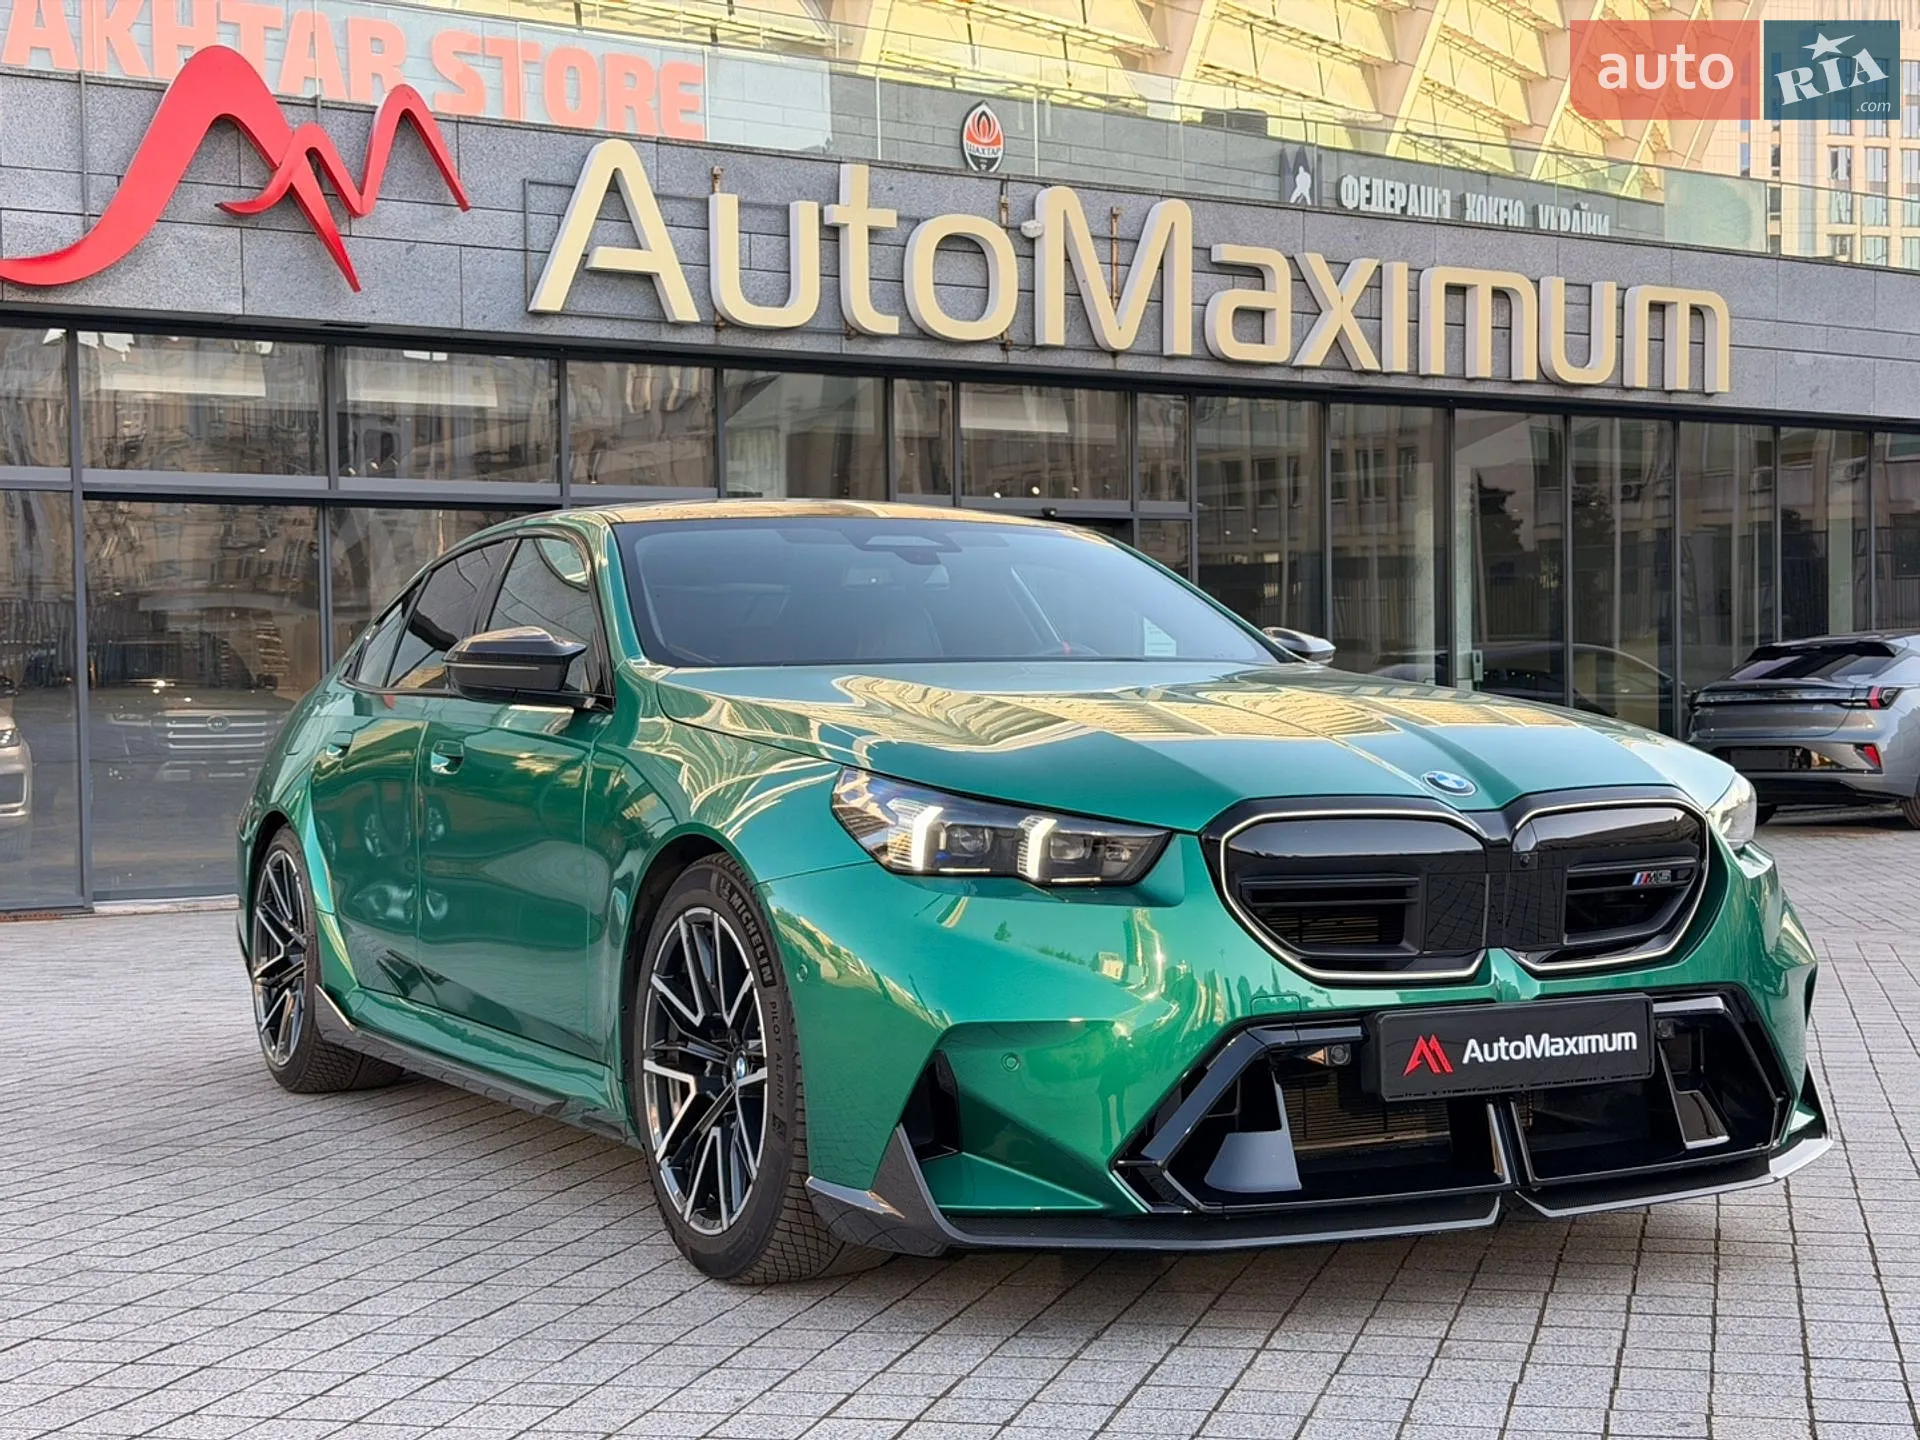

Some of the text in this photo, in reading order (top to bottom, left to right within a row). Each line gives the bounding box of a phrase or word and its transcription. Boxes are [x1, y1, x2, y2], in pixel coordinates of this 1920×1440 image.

[431, 29, 705, 141] STORE
[527, 138, 1731, 393] AutoMaximum
[729, 891, 774, 982] MICHELIN
[769, 1001, 782, 1044] PILOT
[1462, 1031, 1638, 1065] AutoMaximum
